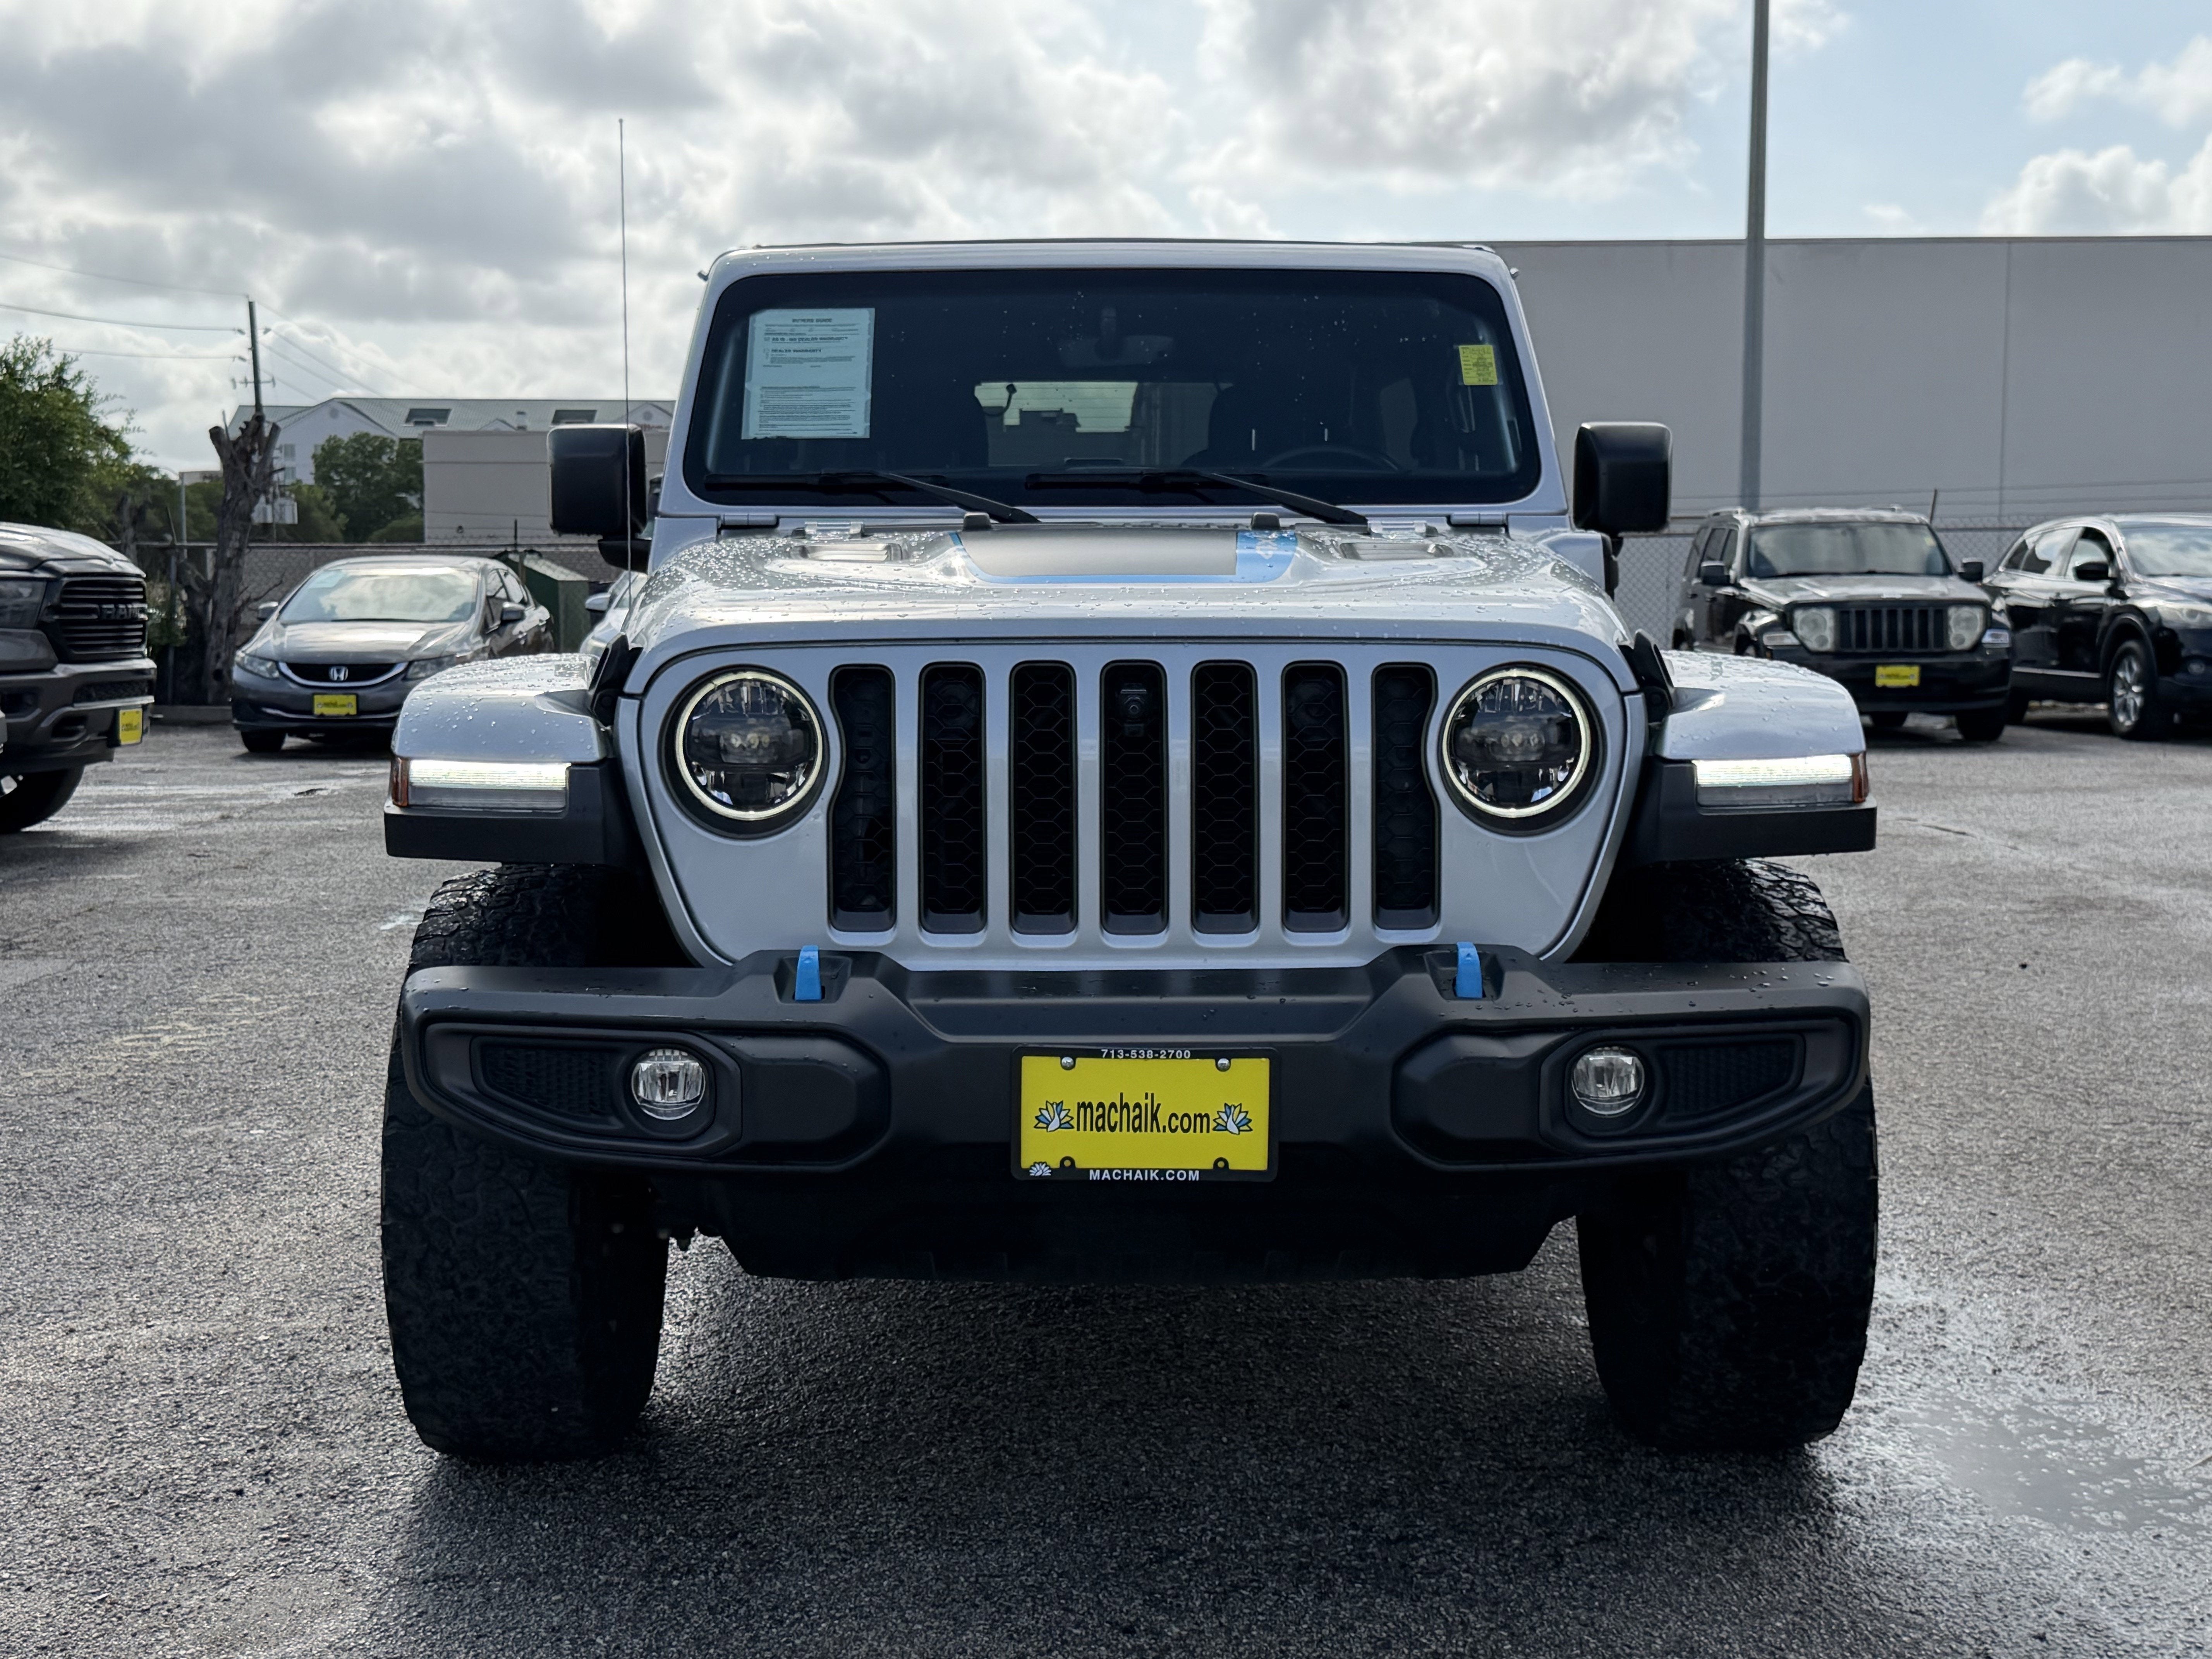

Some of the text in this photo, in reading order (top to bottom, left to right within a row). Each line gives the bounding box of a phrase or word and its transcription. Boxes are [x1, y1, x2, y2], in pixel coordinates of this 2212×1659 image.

[1101, 1049, 1190, 1058] 713-538-2700
[1077, 1092, 1210, 1133] machaik.com
[1090, 1170, 1199, 1180] MACHAIK.COM
